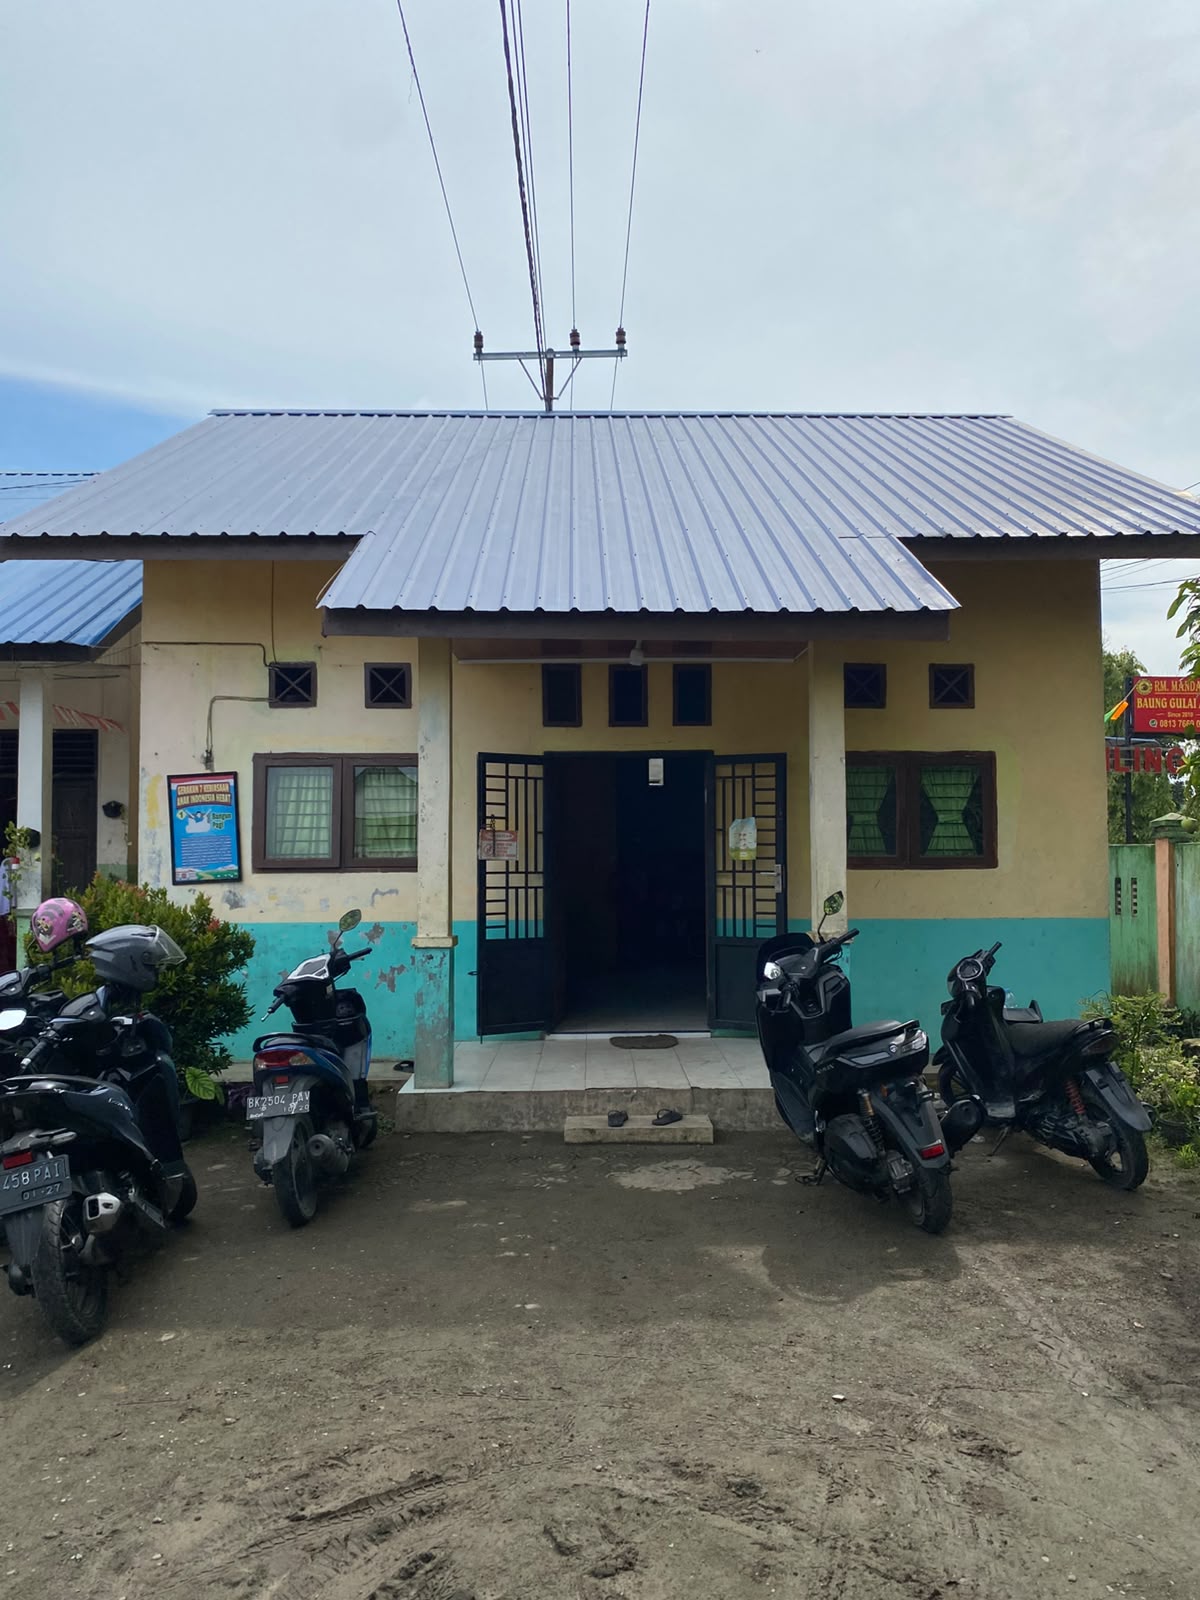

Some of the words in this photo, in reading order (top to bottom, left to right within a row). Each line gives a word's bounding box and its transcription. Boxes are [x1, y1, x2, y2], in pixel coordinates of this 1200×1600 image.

[1136, 697, 1168, 709] BAUNG
[1169, 697, 1197, 709] GULAI
[1159, 719, 1177, 728] 0813
